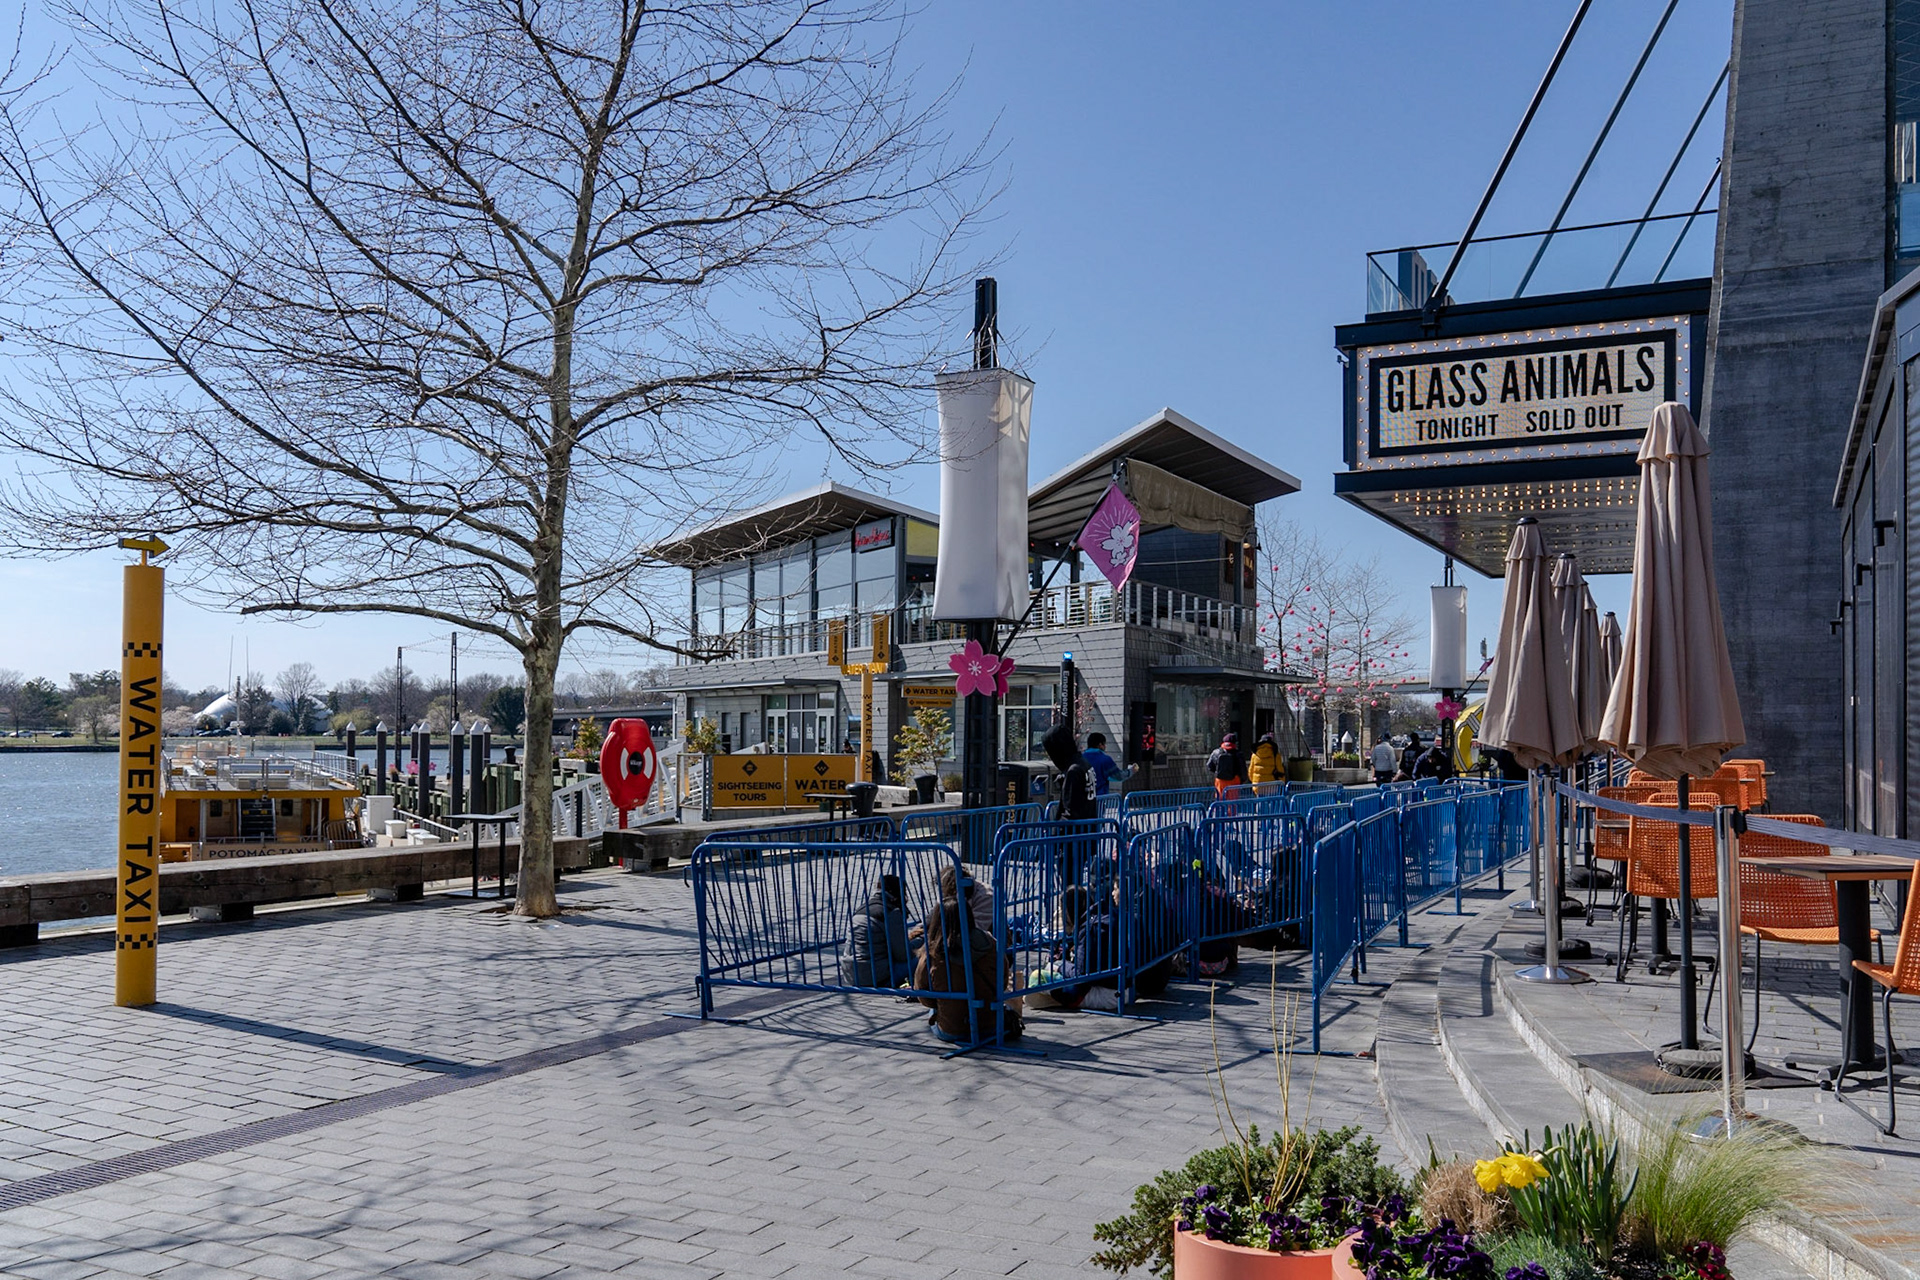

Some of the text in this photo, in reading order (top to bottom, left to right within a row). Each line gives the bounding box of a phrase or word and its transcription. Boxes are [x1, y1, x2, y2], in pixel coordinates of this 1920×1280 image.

[1388, 346, 1655, 413] GLASS ANIMALS
[1416, 404, 1624, 441] TONIGHT SOLD OUT
[1061, 670, 1070, 717] Emergency
[717, 781, 782, 791] SIGHTSEEING
[795, 779, 846, 790] WATER
[1005, 781, 1016, 792] in
[124, 676, 156, 923] WATER TAXI
[733, 793, 767, 801] TOURS
[209, 849, 276, 858] POTOMAC
